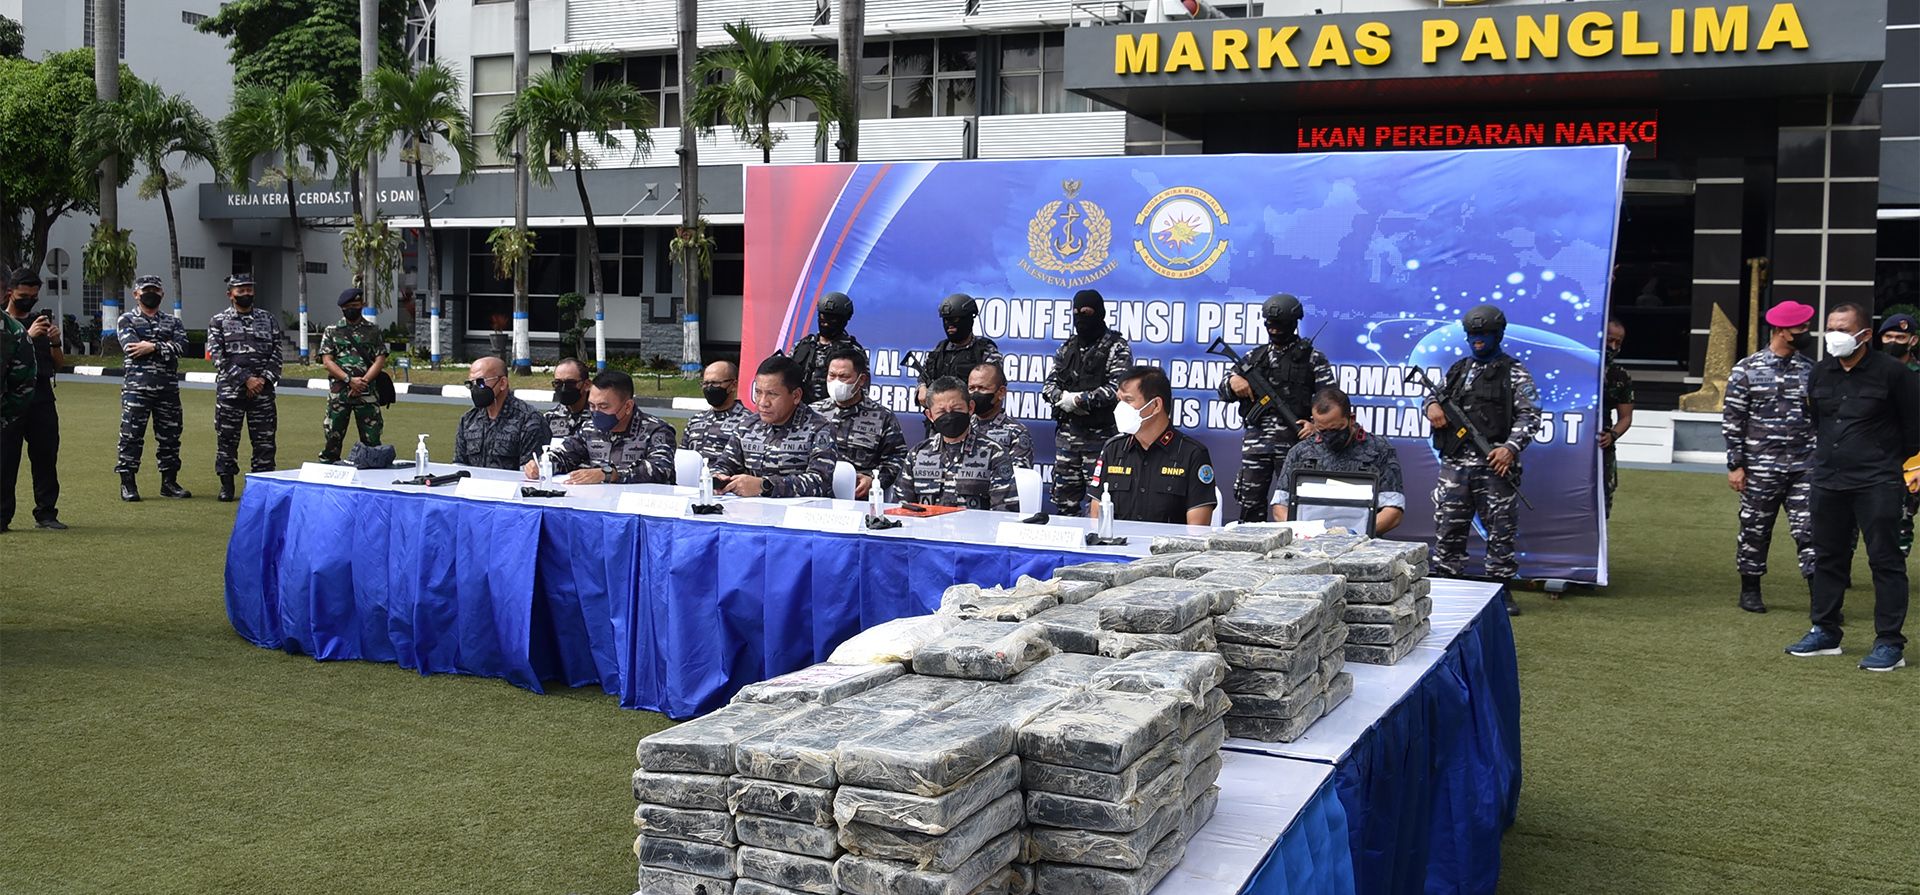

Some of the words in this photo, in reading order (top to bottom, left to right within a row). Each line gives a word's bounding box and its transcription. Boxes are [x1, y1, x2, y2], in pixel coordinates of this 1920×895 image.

[1114, 22, 1391, 74] MARKAS
[1420, 3, 1809, 63] PANGLIMA
[1298, 127, 1365, 147] LKAN
[1375, 123, 1544, 146] PEREDARAN
[1555, 120, 1657, 143] NARKO
[228, 194, 259, 206] KERJA
[390, 190, 414, 202] DAN
[1018, 258, 1067, 287] JALESVEVA
[1067, 258, 1119, 289] JAYAMAHE
[1144, 254, 1176, 277] KOMANDO
[973, 298, 1185, 344] KONFEENSI
[1197, 301, 1274, 346] PER
[875, 349, 901, 377] AL
[1335, 365, 1445, 398] RMADA
[1562, 413, 1584, 446] T
[625, 453, 636, 461] TNI
[915, 469, 941, 478] ARSYAD
[960, 470, 974, 478] TNI
[1161, 466, 1185, 476] BNNP
